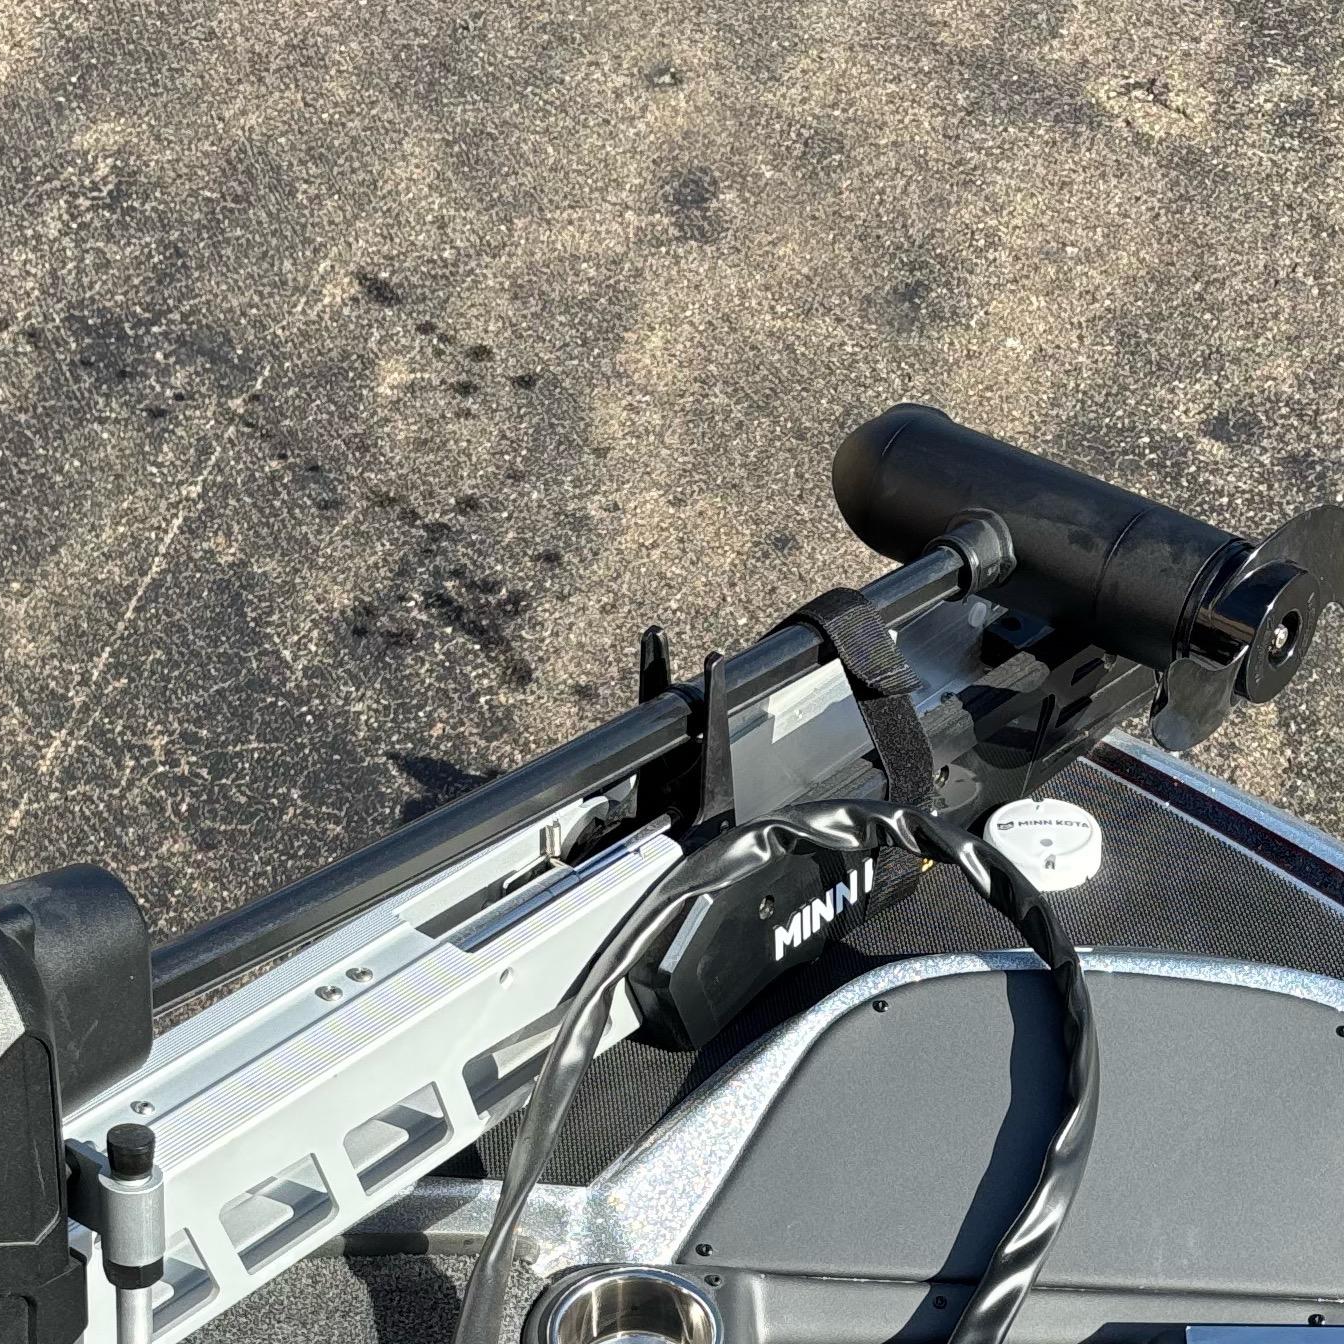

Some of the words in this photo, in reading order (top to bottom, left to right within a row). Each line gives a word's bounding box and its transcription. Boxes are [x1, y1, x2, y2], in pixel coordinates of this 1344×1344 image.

[1017, 819, 1053, 828] MINN
[1055, 819, 1090, 829] KOTA
[774, 868, 858, 962] MINN
